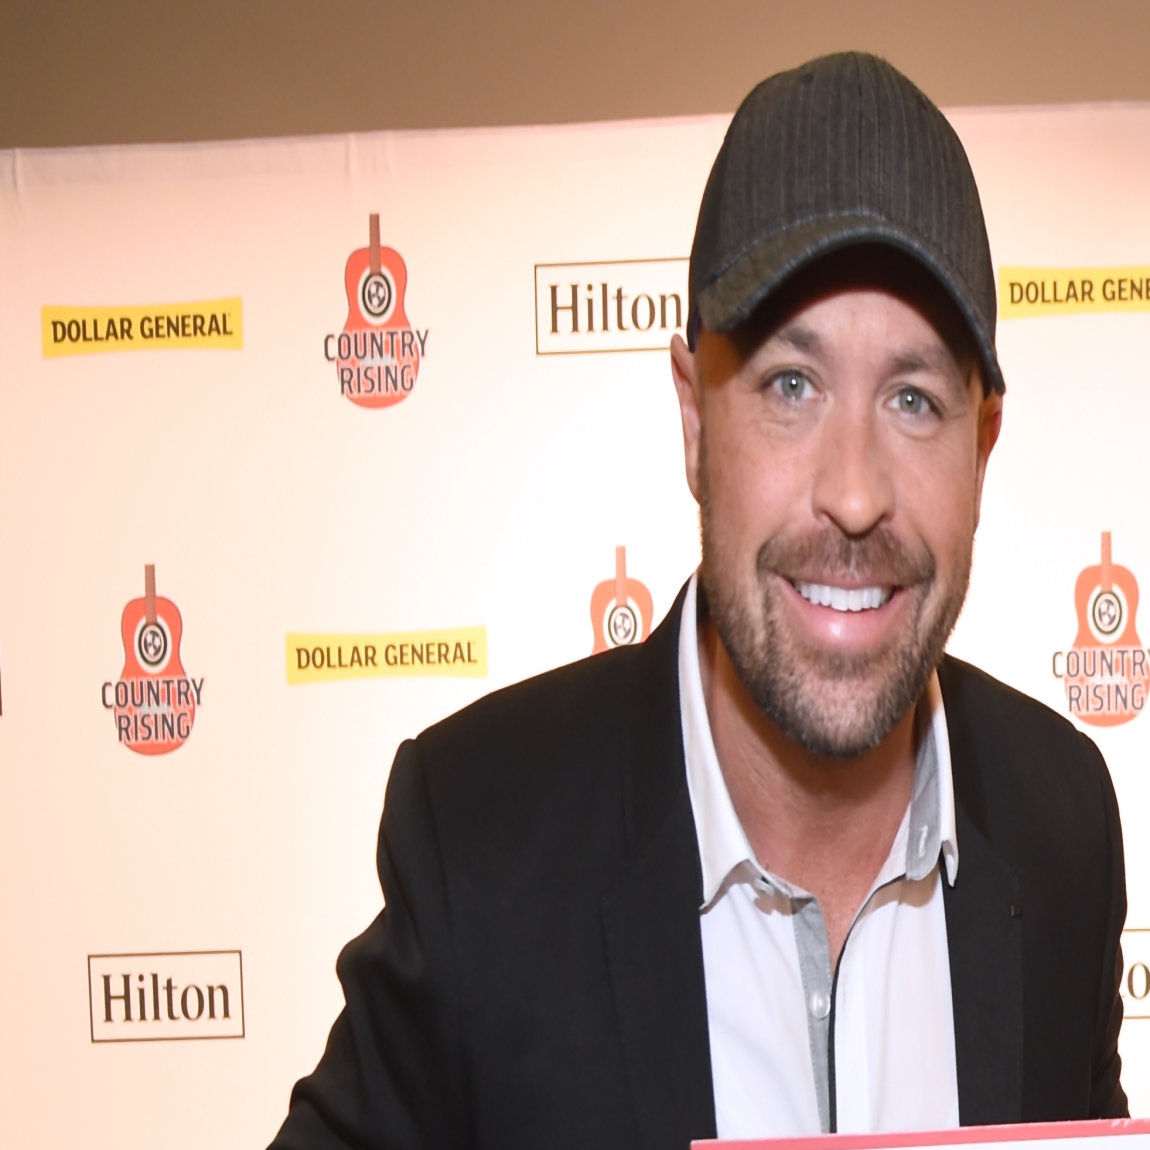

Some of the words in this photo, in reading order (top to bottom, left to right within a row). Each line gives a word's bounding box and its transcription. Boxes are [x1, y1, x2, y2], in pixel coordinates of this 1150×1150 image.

[1010, 280, 1093, 303] DOLLAR
[550, 282, 682, 333] Hilton
[52, 318, 133, 343] DOLLAR
[140, 314, 232, 339] GENERAL
[323, 329, 429, 361] COUNTRY
[340, 365, 414, 395] RISING
[296, 646, 376, 669] DOLLAR
[385, 642, 477, 665] GENERAL
[102, 679, 203, 708] COUNTRY
[1069, 684, 1143, 711] RISING
[115, 713, 190, 741] RISING
[103, 974, 229, 1022] Hilton
